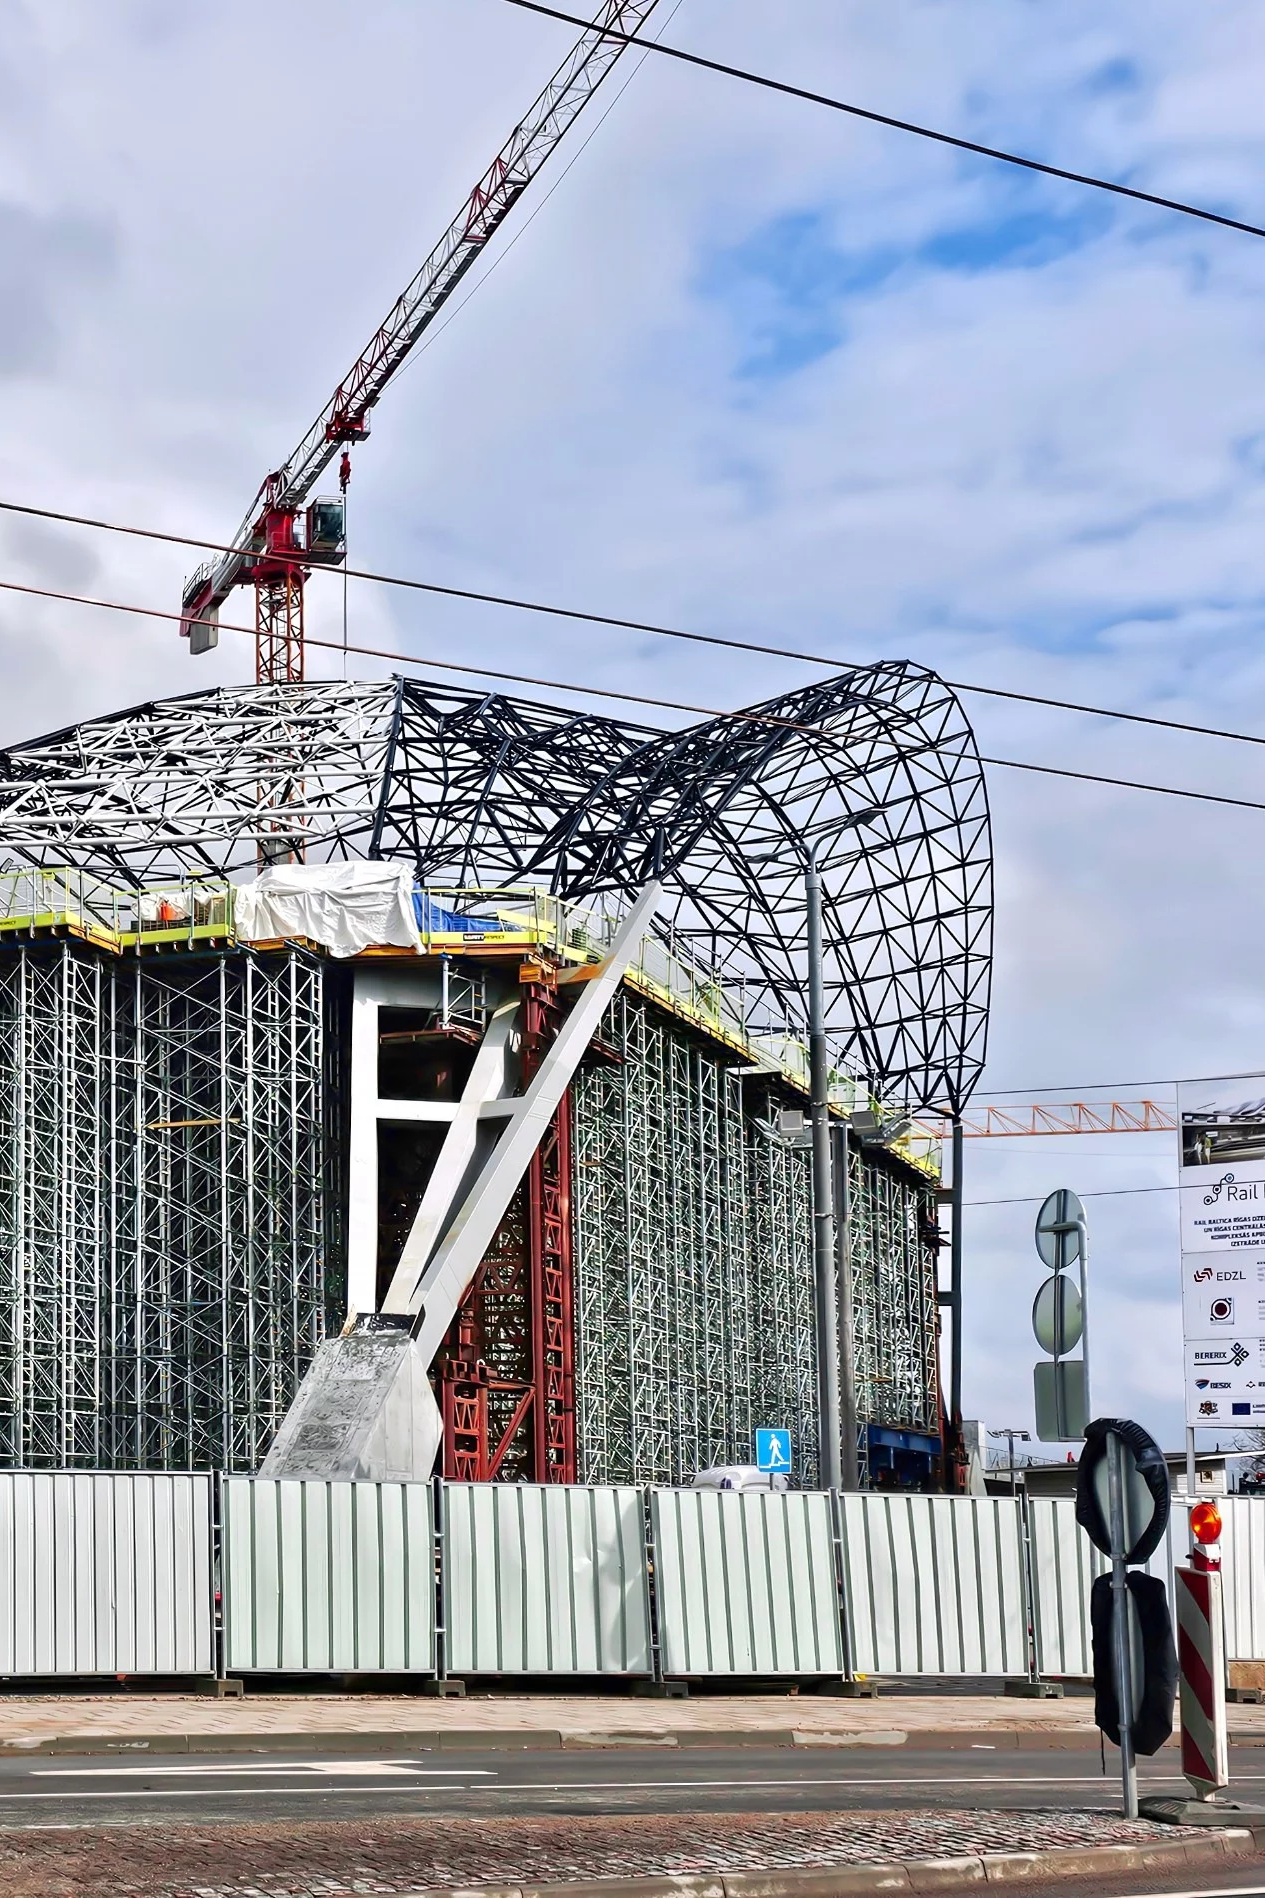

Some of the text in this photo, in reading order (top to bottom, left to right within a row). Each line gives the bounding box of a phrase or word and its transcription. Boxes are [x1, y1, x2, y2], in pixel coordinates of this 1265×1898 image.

[1227, 1184, 1258, 1201] Rail
[1216, 1270, 1247, 1281] EDZL
[1194, 1351, 1227, 1360] BERERIX
[1210, 1382, 1232, 1390] BESIX
